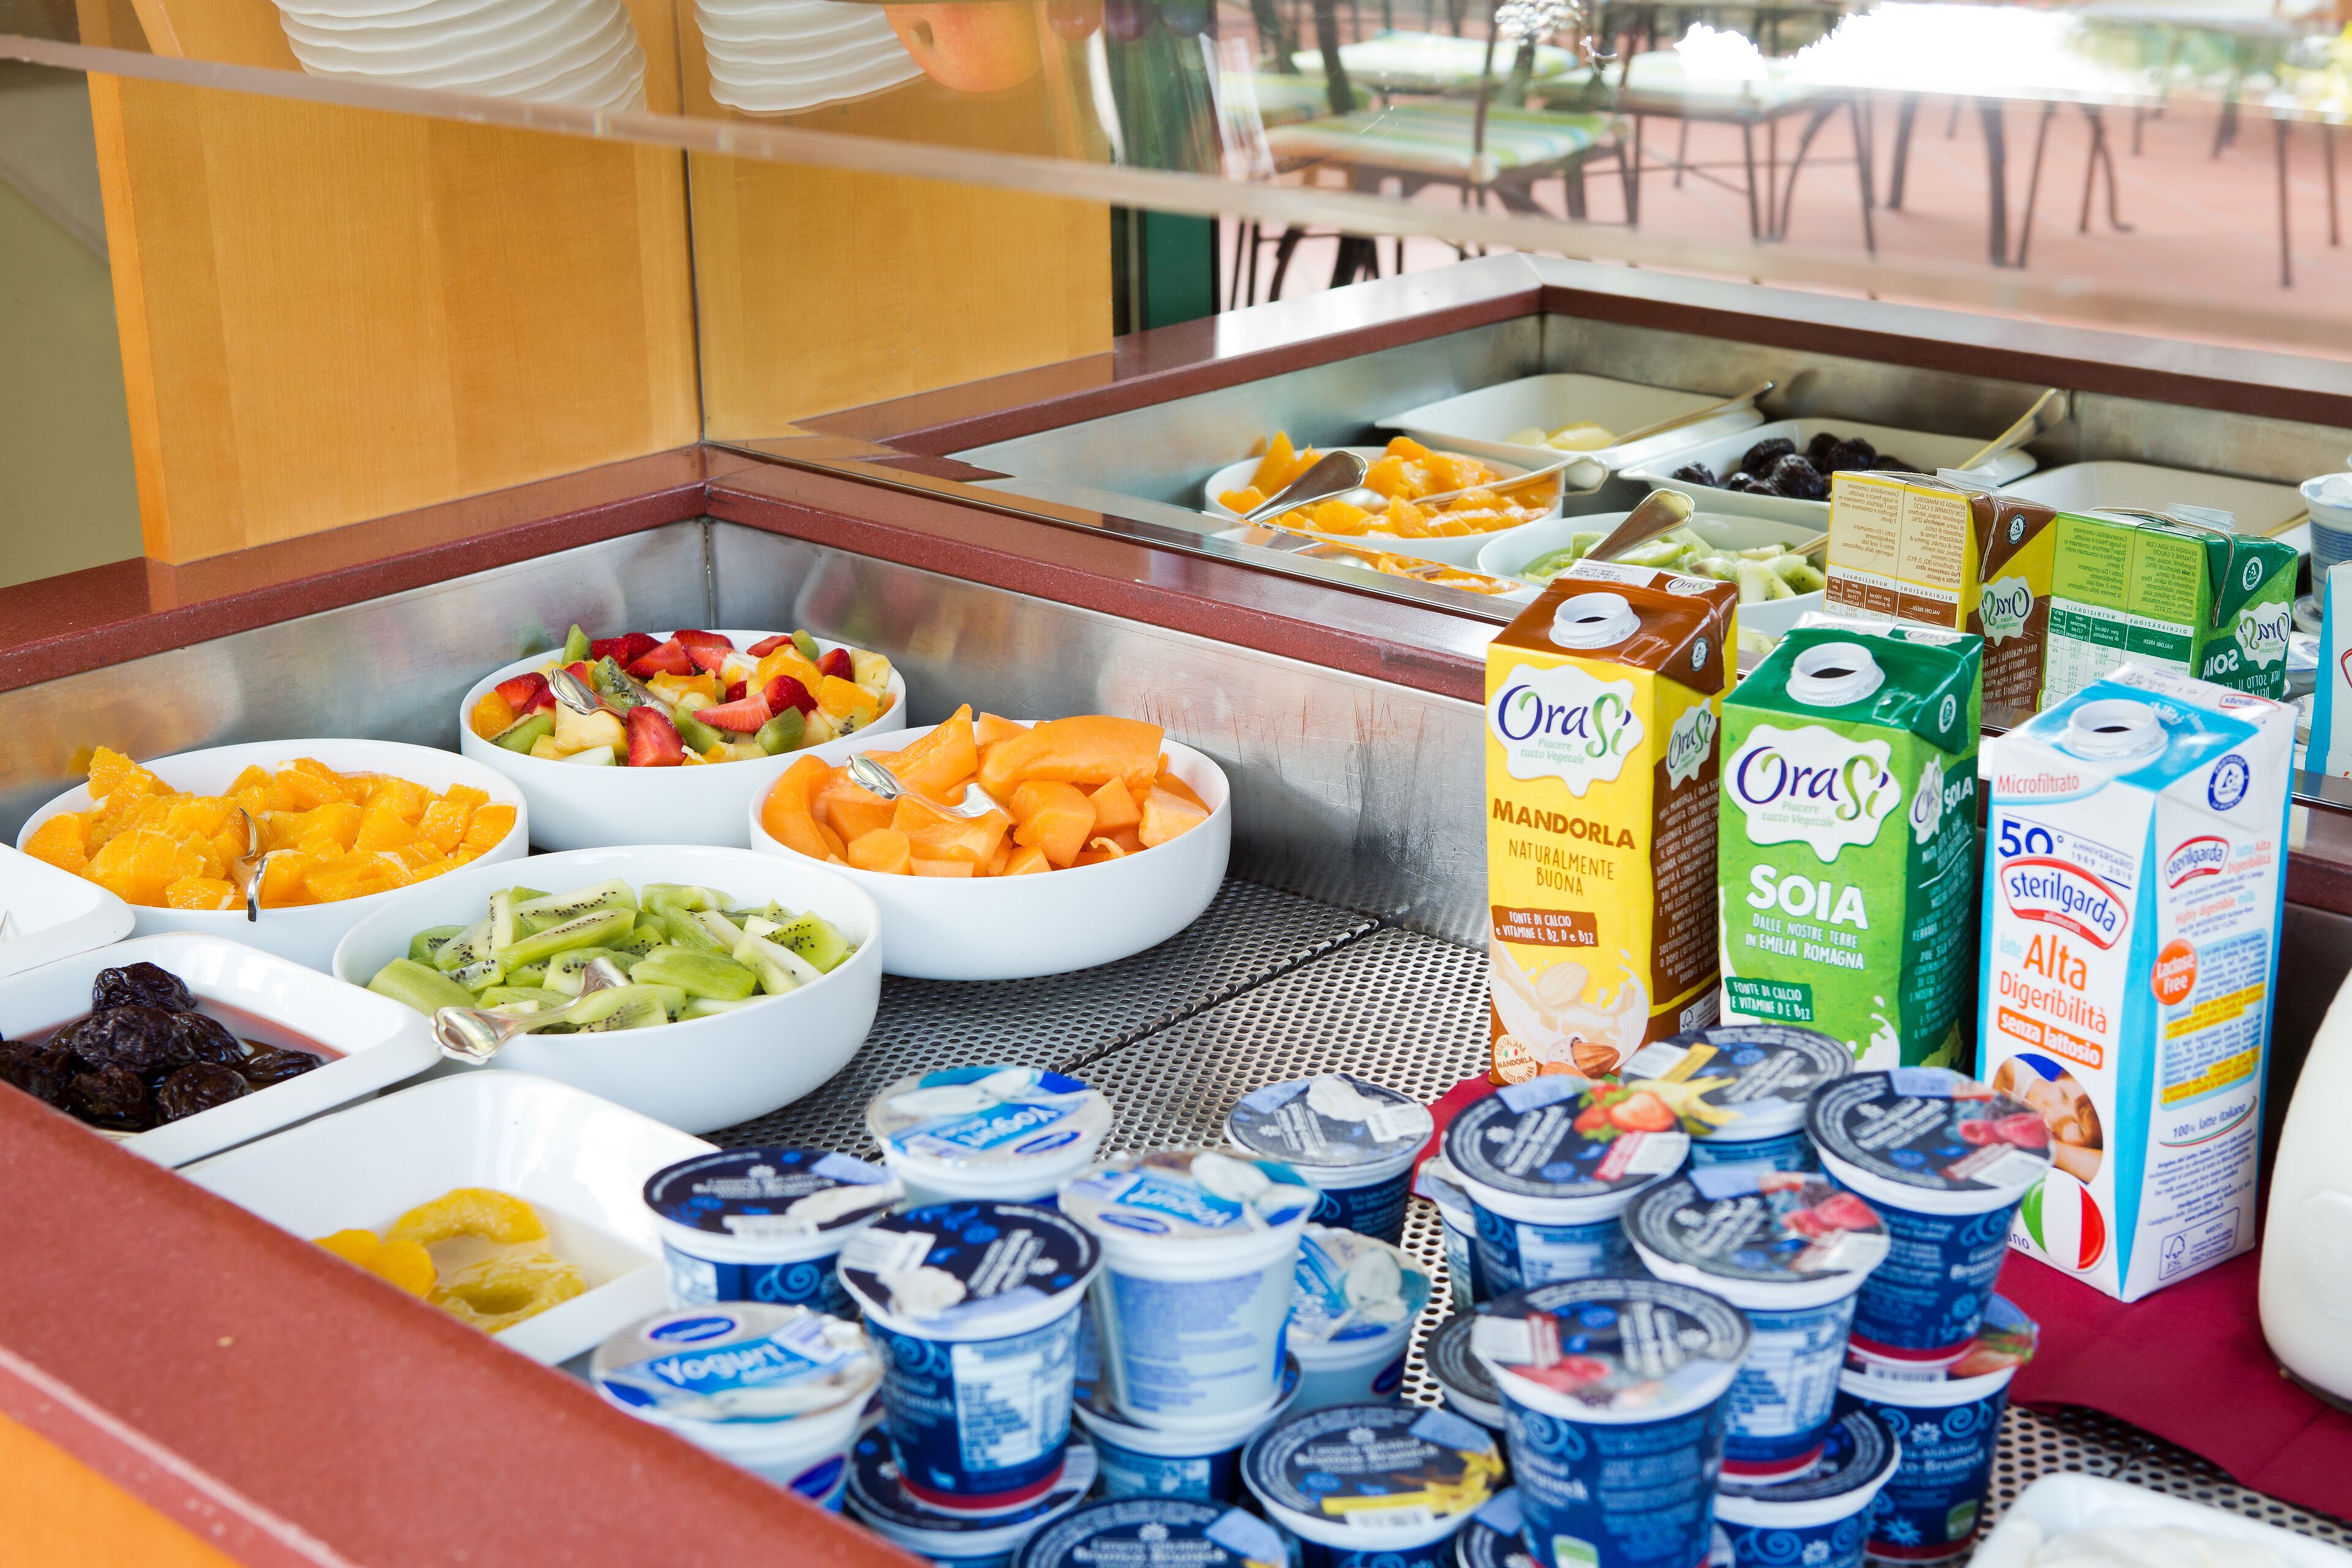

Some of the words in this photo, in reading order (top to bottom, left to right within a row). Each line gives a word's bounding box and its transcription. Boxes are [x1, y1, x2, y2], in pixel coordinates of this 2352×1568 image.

[1521, 748, 1544, 758] tutto
[1547, 750, 1585, 764] Vegetale
[1539, 738, 1572, 750] Piacere
[1944, 776, 1974, 814] SOIA
[1997, 774, 2079, 793] Microfiltrato
[1782, 801, 1820, 813] Piacere
[1493, 799, 1635, 850] MANDORLA
[1762, 813, 1789, 822] tutto
[1792, 815, 1835, 827] Vegetale
[1509, 839, 1614, 880] NATURALMENTE
[2073, 841, 2133, 870] ANNIVERSARIO
[2169, 843, 2223, 878] sterilgarda
[2236, 845, 2253, 856] latte
[2256, 840, 2271, 851] Alta
[2071, 851, 2095, 866] 1969
[2109, 866, 2132, 881] 2019
[2228, 854, 2271, 874] Digeribilità
[1537, 867, 1583, 896] BUONA
[1746, 863, 1870, 930] SOIA
[2011, 872, 2116, 932] sterilgarda
[2176, 909, 2196, 924] Highly
[2199, 897, 2235, 916] digestible
[2238, 891, 2255, 904] milk
[1509, 911, 1532, 924] FONTE
[1534, 914, 1542, 925] DI
[1544, 914, 1572, 927] CALCIO
[1752, 912, 1783, 933] DALLE
[1787, 921, 1825, 942] NOSTRE
[1829, 930, 1859, 949] TERRE
[1502, 925, 1536, 939] VITAMINE
[1561, 929, 1567, 941] D
[1578, 930, 1594, 944] B12
[1745, 932, 1757, 948] IN
[1759, 933, 1798, 957] EMILIA
[1803, 941, 1865, 971] ROMAGNA
[2000, 933, 2022, 959] latte
[2024, 934, 2087, 991] Alta
[2157, 954, 2195, 979] Lactose
[1733, 982, 1760, 995] FONTE
[1761, 985, 1770, 997] DI
[1773, 987, 1802, 1001] CALCIO
[2163, 974, 2188, 995] Free
[1732, 996, 1736, 1008] E
[1739, 997, 1775, 1013] VITAMINE
[1777, 1002, 1783, 1014] D
[1785, 1004, 1792, 1016] E
[1794, 1004, 1811, 1020] B12
[2000, 971, 2107, 1034] Digeribilità
[1502, 1038, 1526, 1053] ITALIANA
[2000, 1013, 2042, 1042] senza
[2044, 1026, 2101, 1066] lattosio
[1498, 1057, 1534, 1068] MANDORLA
[1517, 1066, 1534, 1083] ITALIANA
[2199, 1117, 2217, 1129] latte
[2220, 1104, 2245, 1122] italiano
[655, 1342, 786, 1385] Yogurt
